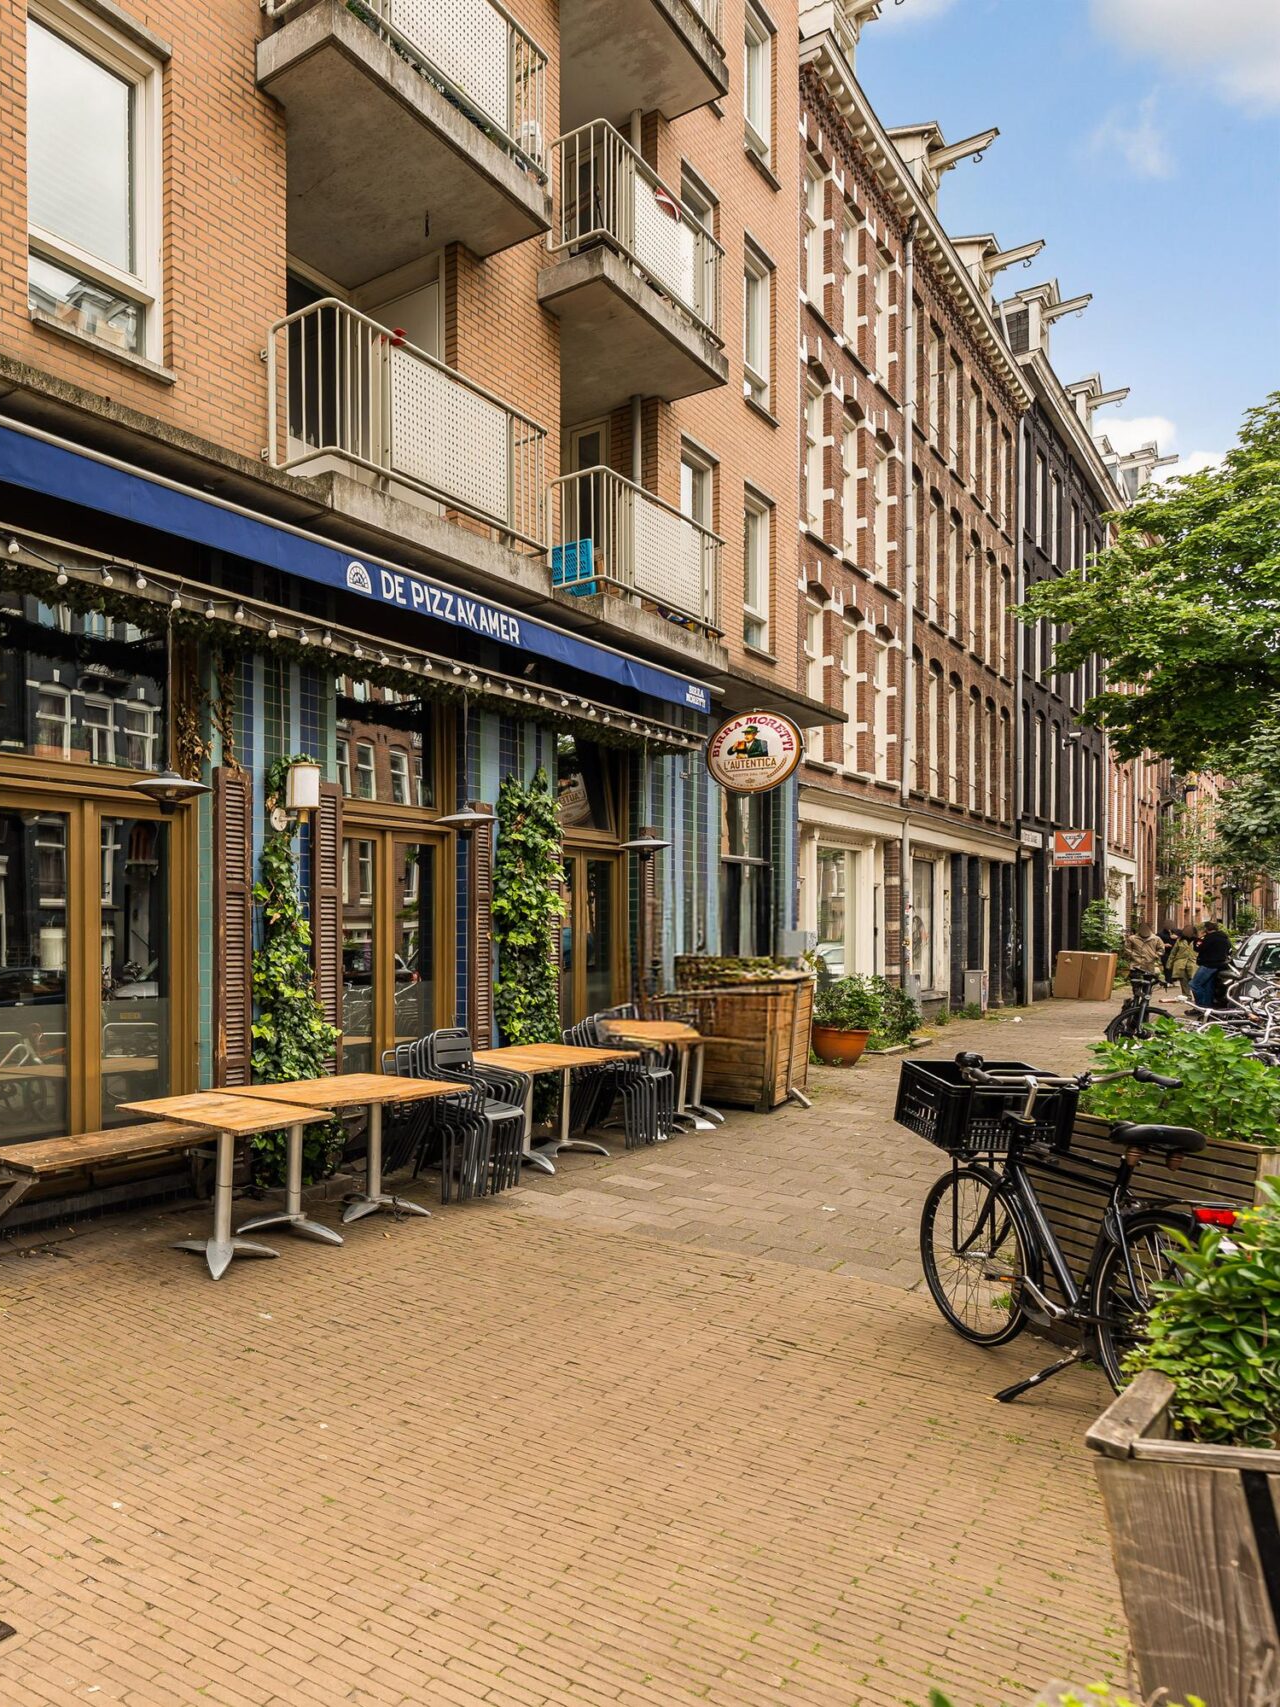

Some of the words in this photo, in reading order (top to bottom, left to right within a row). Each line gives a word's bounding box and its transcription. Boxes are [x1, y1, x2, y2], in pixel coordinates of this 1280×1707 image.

[380, 569, 407, 605] DE
[410, 580, 520, 645] PIZZAKAMER
[712, 721, 743, 758] BIRRA
[745, 716, 794, 752] MORETTI
[723, 757, 777, 770] L'AUTENTICA
